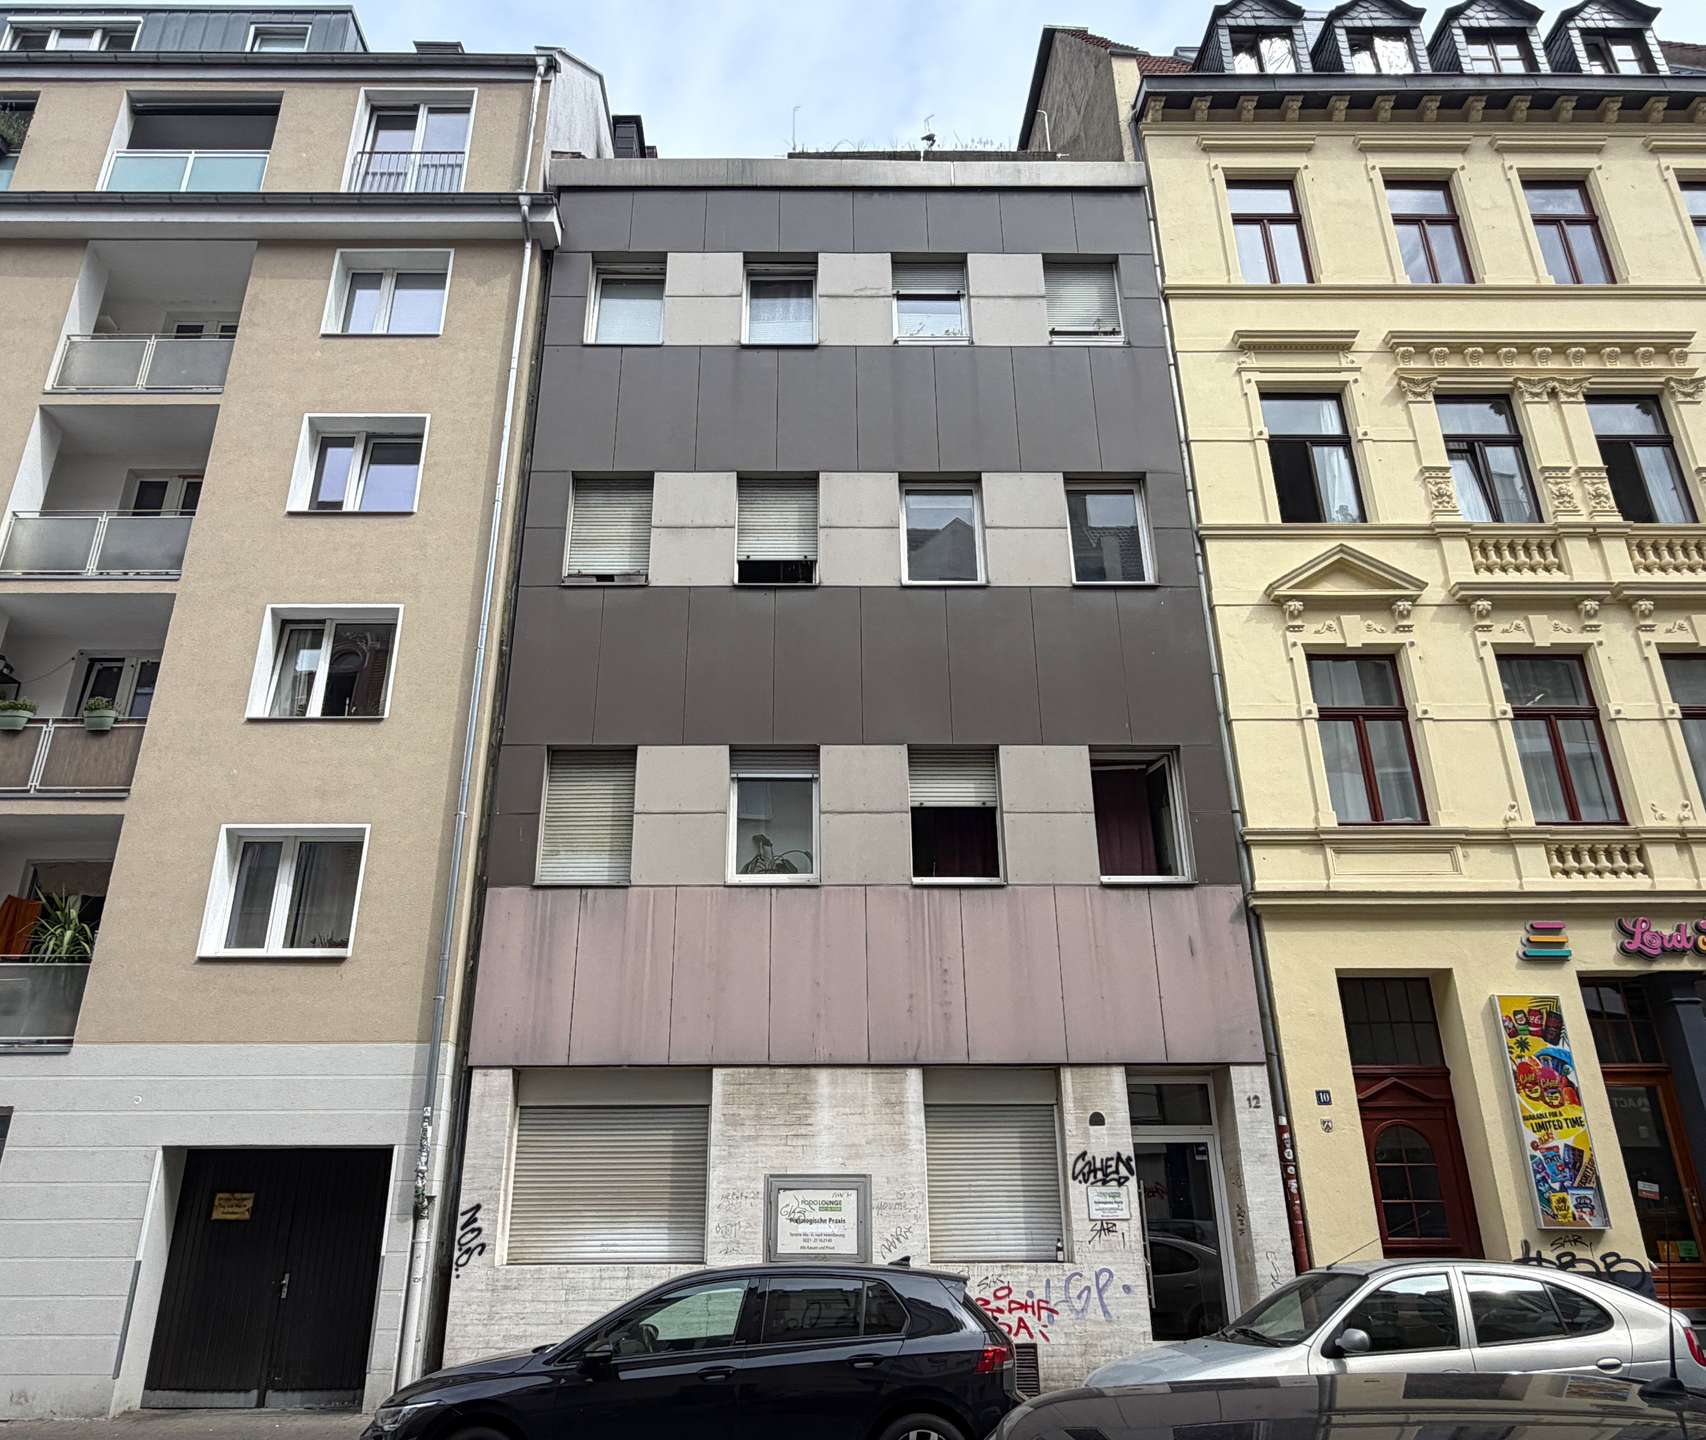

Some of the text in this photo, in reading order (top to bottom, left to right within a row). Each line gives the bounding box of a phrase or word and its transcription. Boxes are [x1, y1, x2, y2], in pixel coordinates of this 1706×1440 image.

[1246, 1094, 1262, 1109] 12
[1319, 1091, 1331, 1103] 10
[1530, 1116, 1585, 1133] LIMITED TIME
